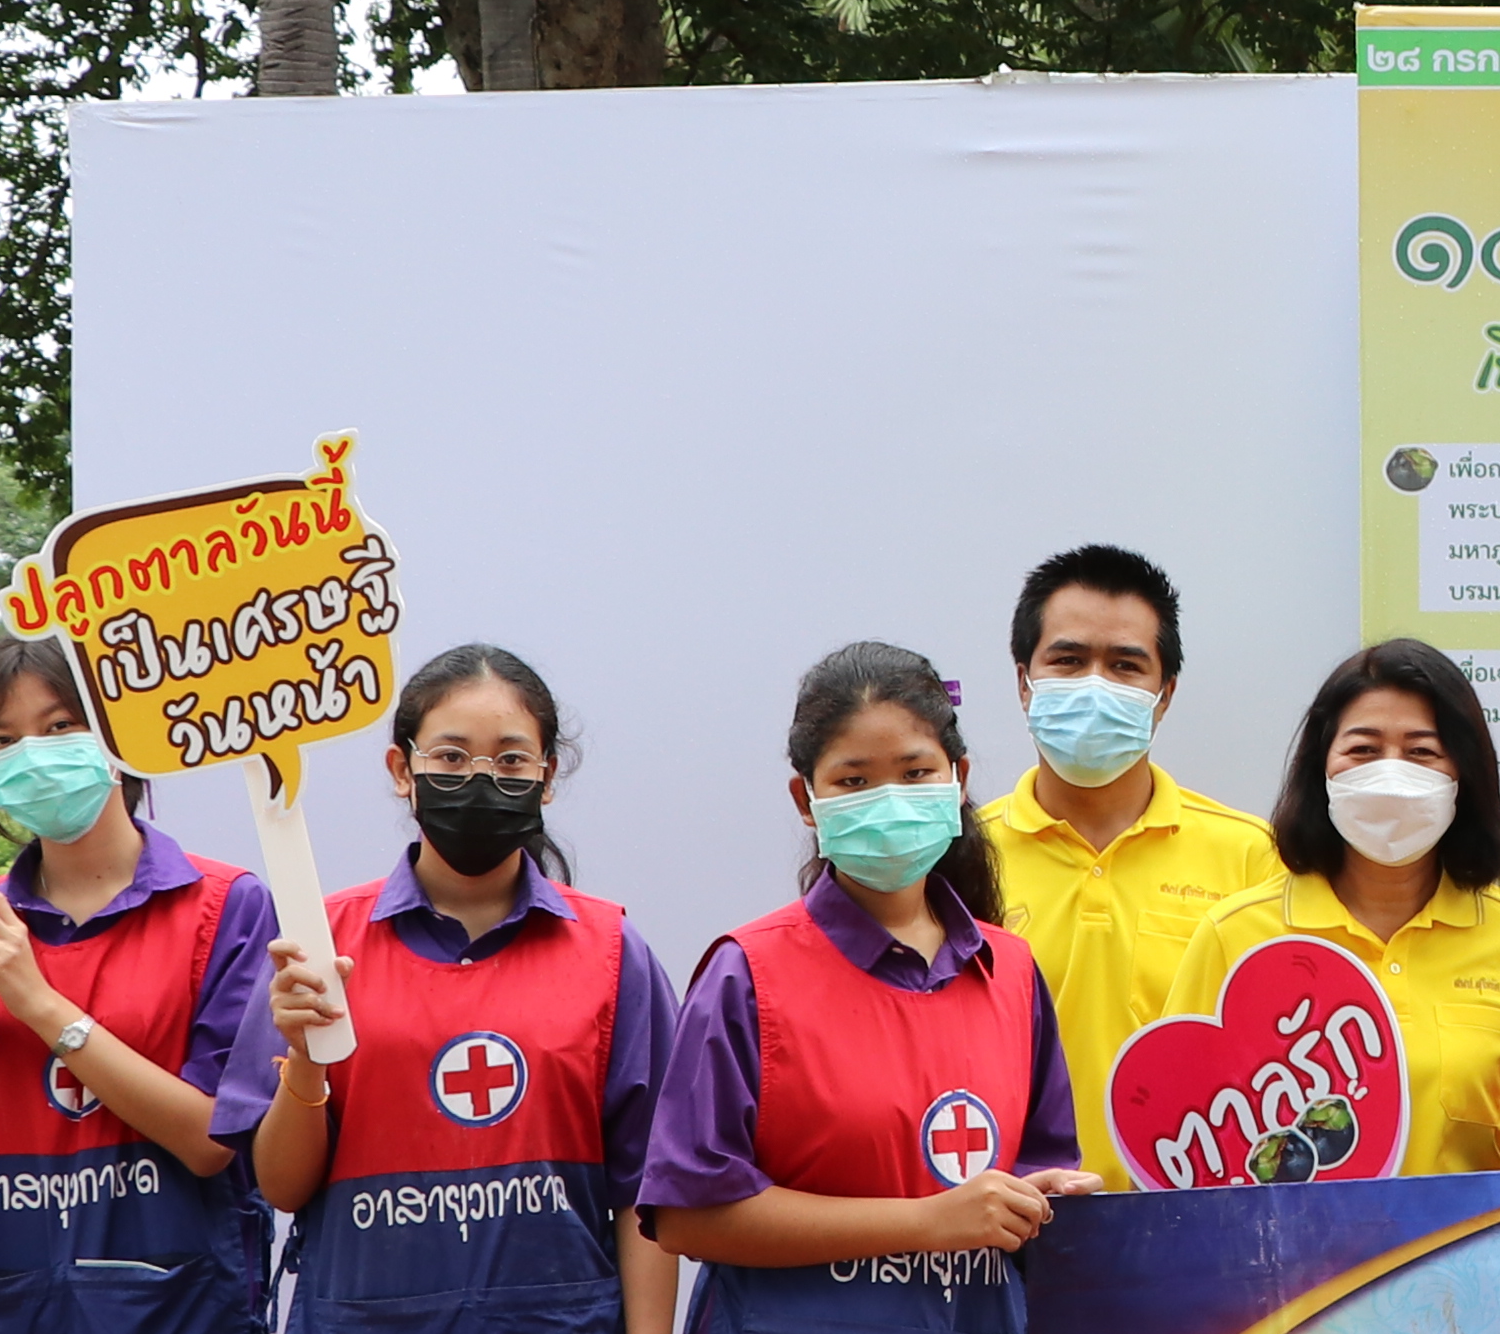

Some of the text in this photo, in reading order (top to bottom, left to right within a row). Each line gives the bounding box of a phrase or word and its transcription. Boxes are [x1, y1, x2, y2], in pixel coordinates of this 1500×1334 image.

[1367, 42, 1421, 73] ๒๘
[9, 440, 351, 636] ปลูกตาลวันนี้
[99, 535, 399, 701] เป็นเศรษฐี
[165, 642, 380, 766] วันหน้า
[1155, 999, 1383, 1190] ตาลรัก
